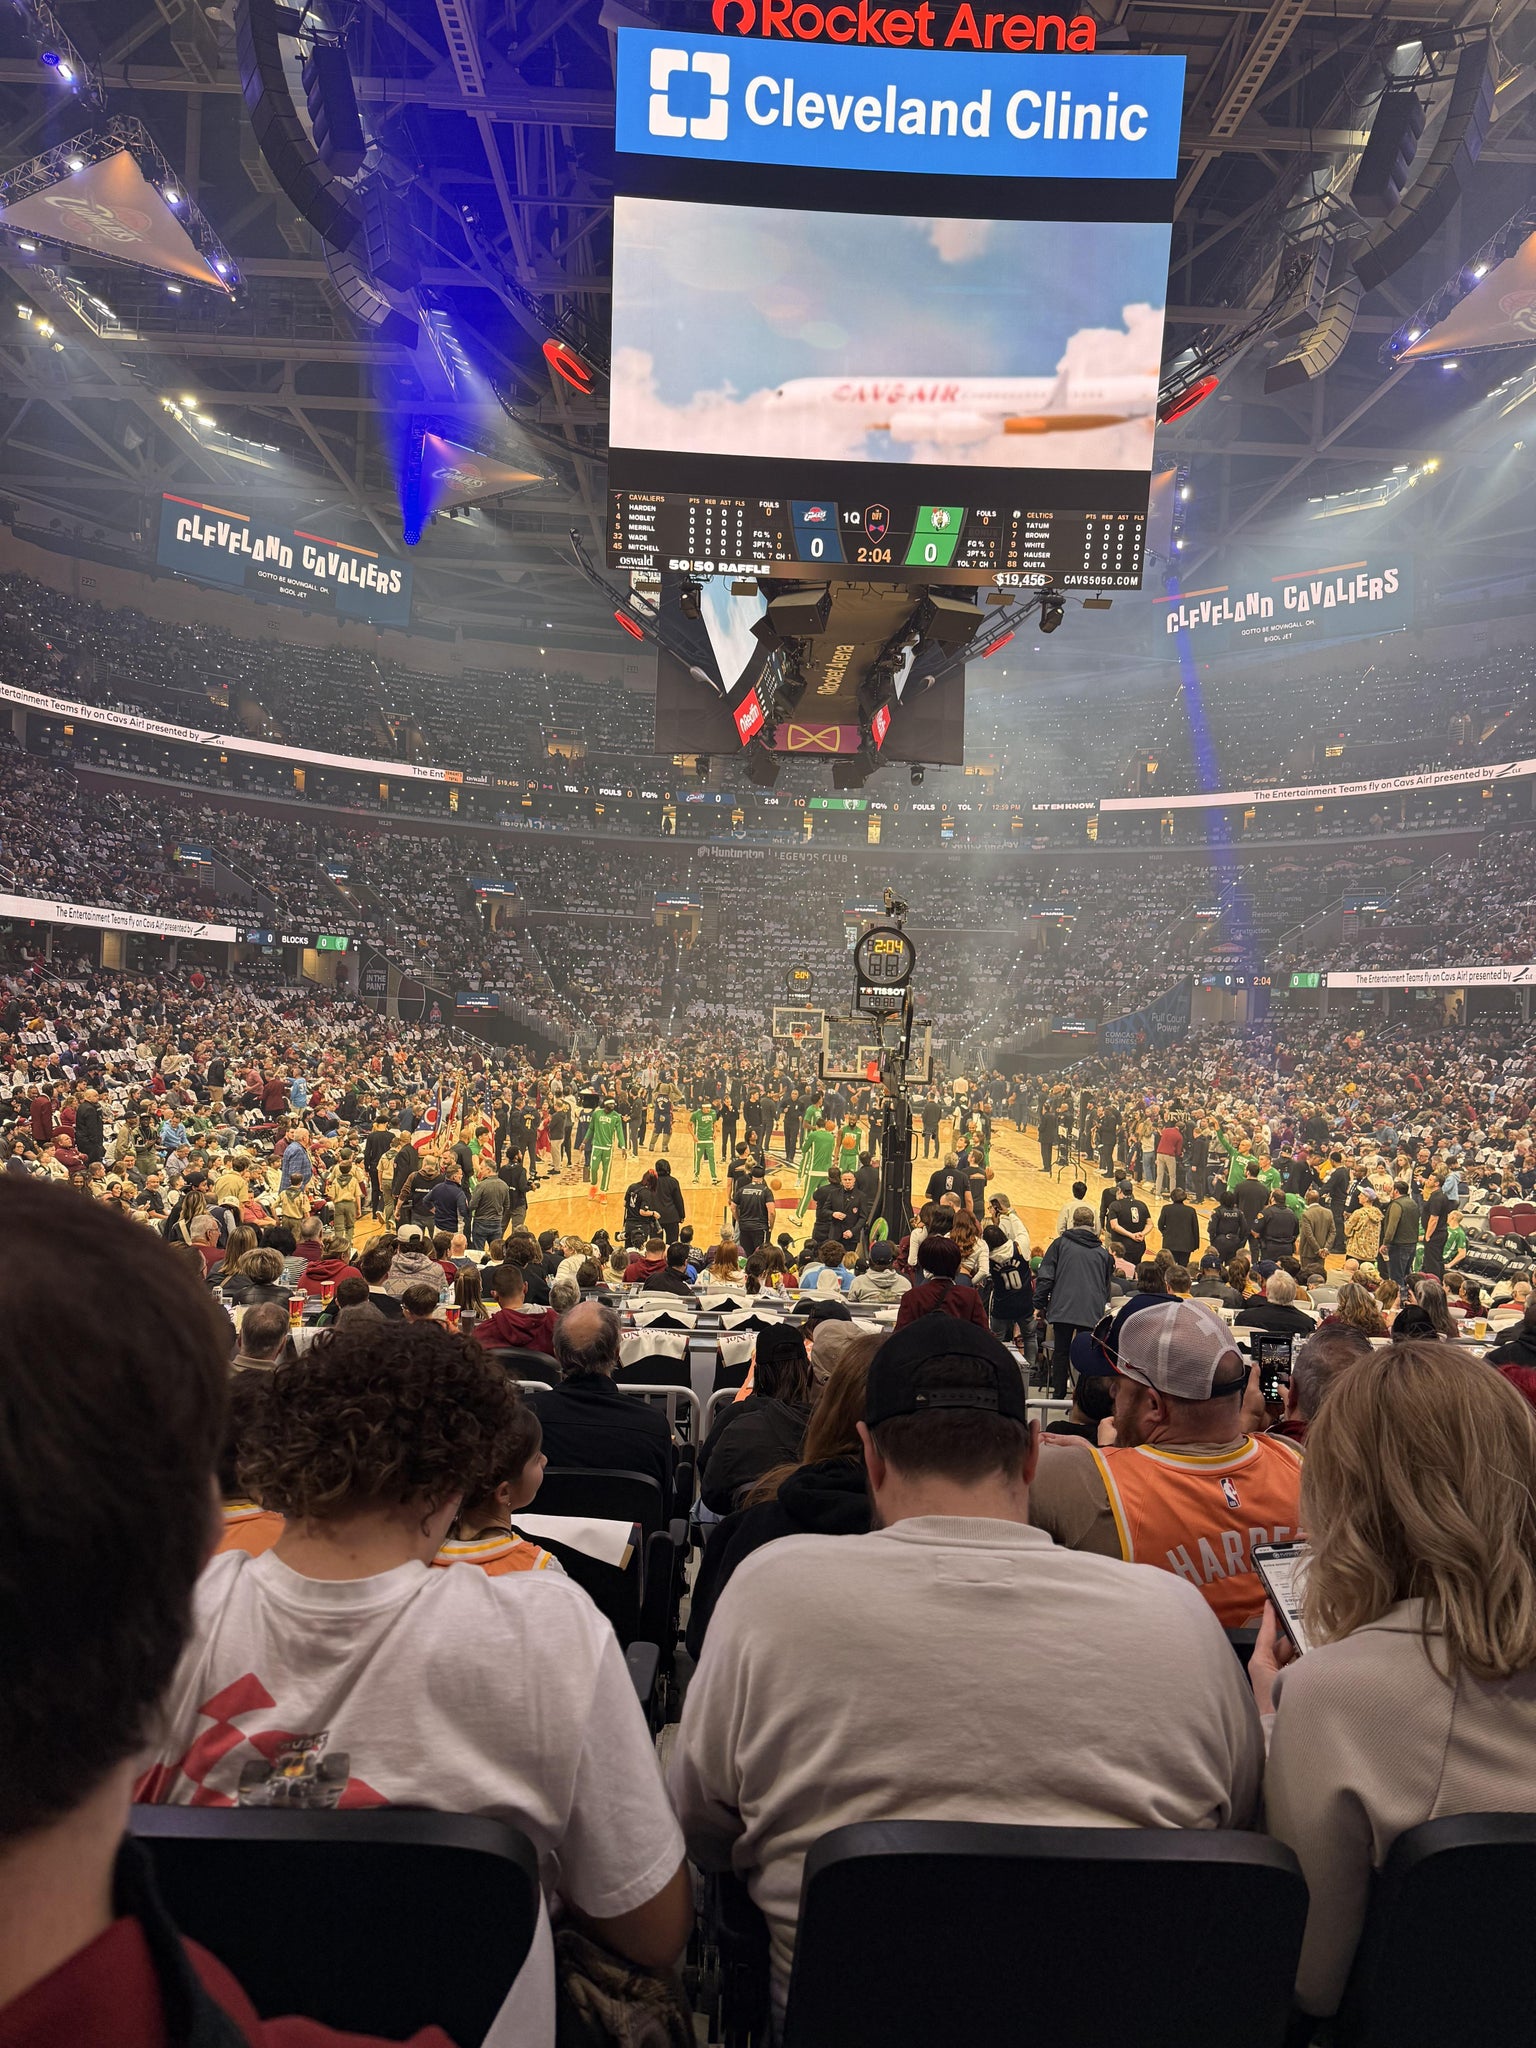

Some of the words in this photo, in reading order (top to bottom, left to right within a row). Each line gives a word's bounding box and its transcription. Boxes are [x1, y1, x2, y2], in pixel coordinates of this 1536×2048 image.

[762, 0, 936, 48] Rocket
[946, 2, 1096, 52] Arena
[744, 75, 992, 137] Cleveland
[1006, 90, 1149, 142] Clinic
[629, 494, 664, 502] CAVALIERS
[843, 512, 860, 524] 1Q
[613, 532, 622, 540] 32
[811, 538, 823, 557] 0
[925, 543, 937, 562] 0
[176, 515, 294, 570] CLEVELAND
[302, 545, 402, 595] CAVALIERS
[620, 554, 654, 566] oswald
[858, 547, 891, 563] 2:04
[718, 563, 770, 574] RAFFLE
[258, 571, 277, 580] GOTTO
[996, 573, 1045, 587] $19,456
[1064, 575, 1138, 586] CAVS5050.COM
[1166, 592, 1273, 633] CLEVELAND
[1284, 568, 1399, 612] CAVALIERS
[51, 700, 78, 714] Teams
[81, 707, 91, 718] fly
[94, 711, 104, 719] on
[107, 713, 127, 724] Cavs
[130, 718, 144, 728] Air!
[147, 722, 187, 737] presented
[190, 732, 199, 741] by
[413, 767, 428, 776] The
[497, 779, 519, 787] $19,456
[1254, 792, 1270, 800] The
[1273, 788, 1336, 799] Entertainment
[1339, 784, 1367, 792] Teams
[1369, 782, 1379, 791] fly
[1394, 778, 1414, 787] Cavs
[1416, 775, 1433, 784] Air!
[1434, 769, 1480, 783] presented
[1483, 768, 1494, 778] by
[564, 785, 578, 793] TOL
[600, 788, 622, 796] FOULS
[56, 906, 68, 918] The
[69, 907, 110, 922] Entertainment
[111, 914, 128, 925] Teams
[143, 918, 154, 928] Cavs
[156, 921, 164, 930] Air!
[165, 922, 186, 934] presented
[186, 925, 193, 935] by
[282, 936, 308, 944] BLOCKS
[874, 939, 903, 954] 2:04
[1253, 977, 1271, 985] 2:04
[1356, 975, 1367, 984] The
[1369, 973, 1405, 983] Entertainment
[1406, 972, 1423, 982] Teams
[1424, 972, 1432, 983] fly
[1433, 973, 1440, 981] on
[1441, 971, 1456, 981] Cavs
[1457, 970, 1467, 981] Air!
[1469, 969, 1502, 982] presented
[1503, 968, 1512, 981] by
[366, 983, 386, 991] PAINT
[874, 987, 905, 996] TISSOT
[1152, 1013, 1165, 1021] Full
[1166, 1014, 1186, 1023] Court
[1157, 1023, 1180, 1032] Power
[1001, 1270, 1023, 1290] 10
